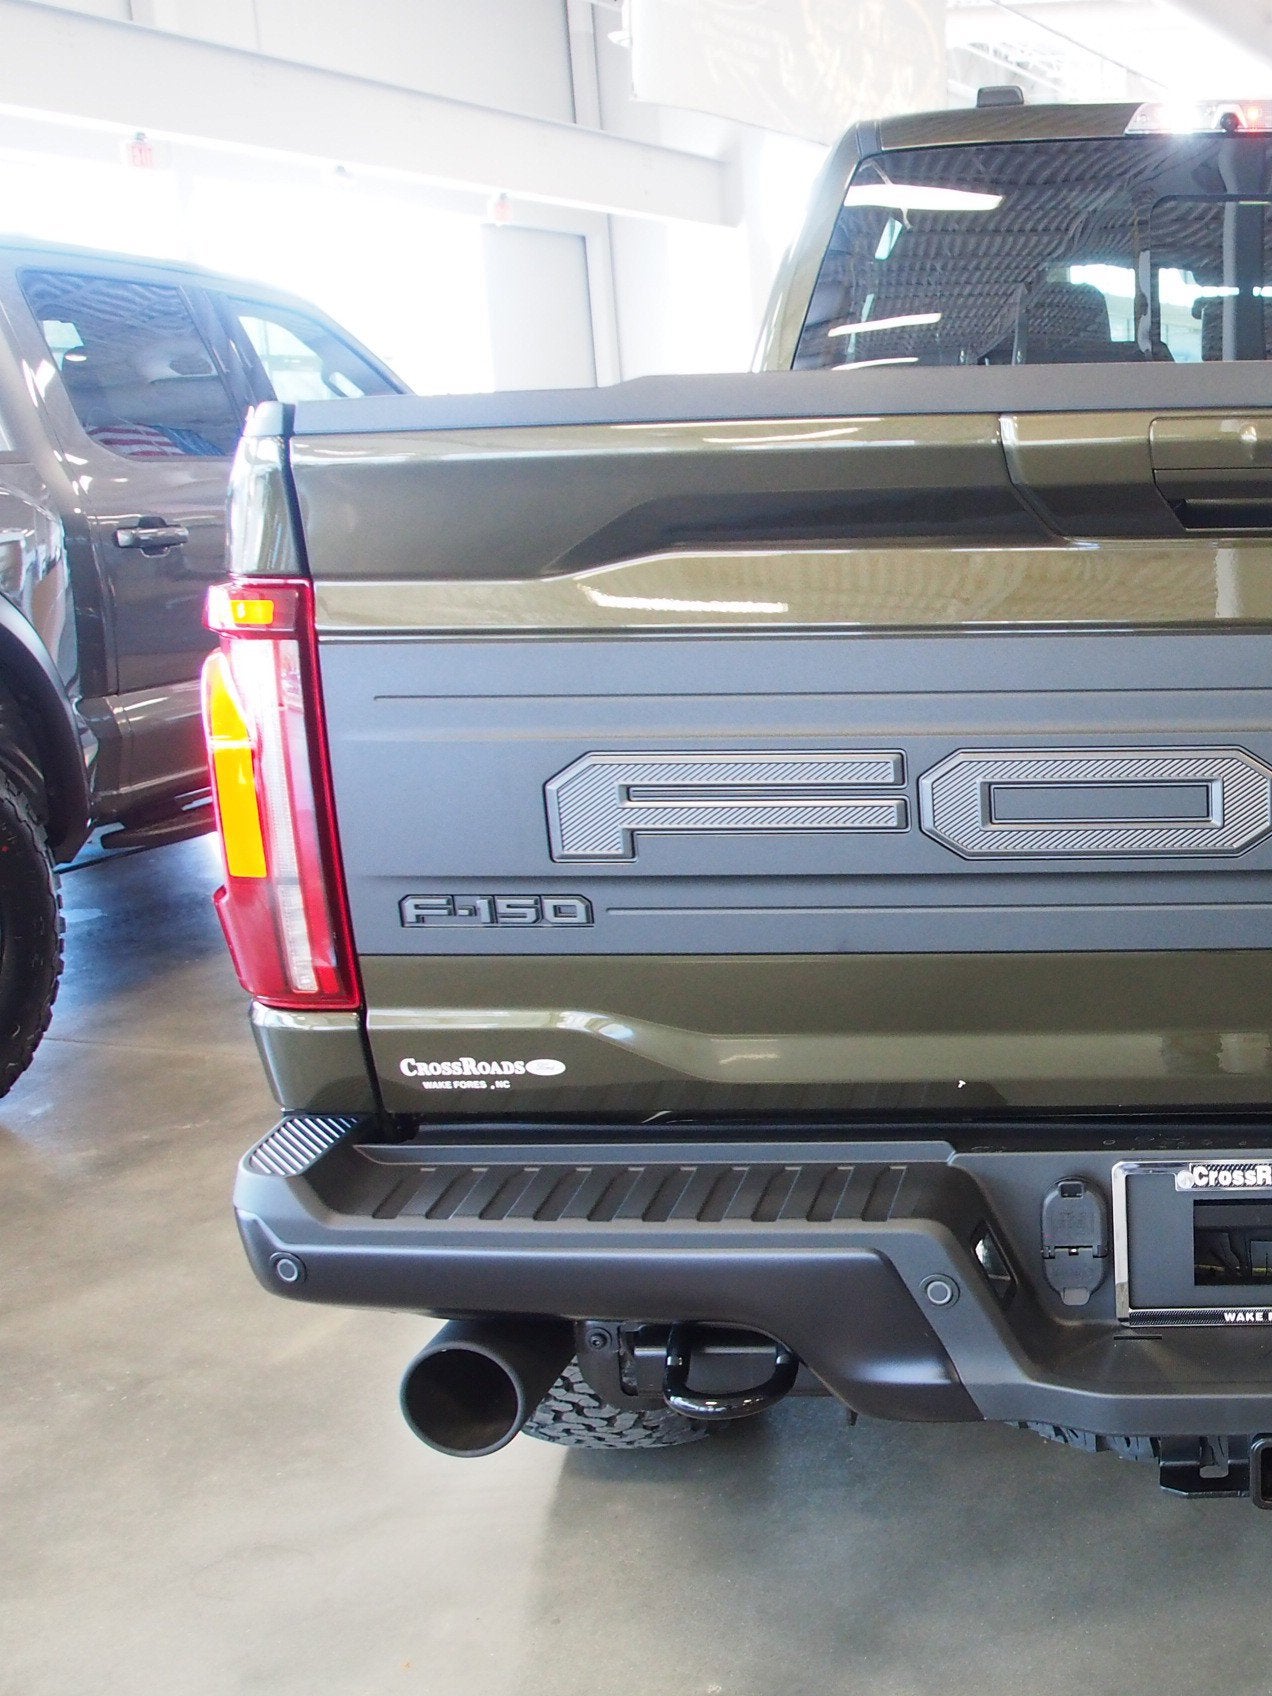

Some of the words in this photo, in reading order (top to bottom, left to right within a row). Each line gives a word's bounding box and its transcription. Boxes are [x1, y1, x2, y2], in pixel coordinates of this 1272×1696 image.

[399, 894, 594, 927] F-150
[422, 1081, 452, 1089] WAKE
[1223, 1312, 1264, 1322] WAKE
